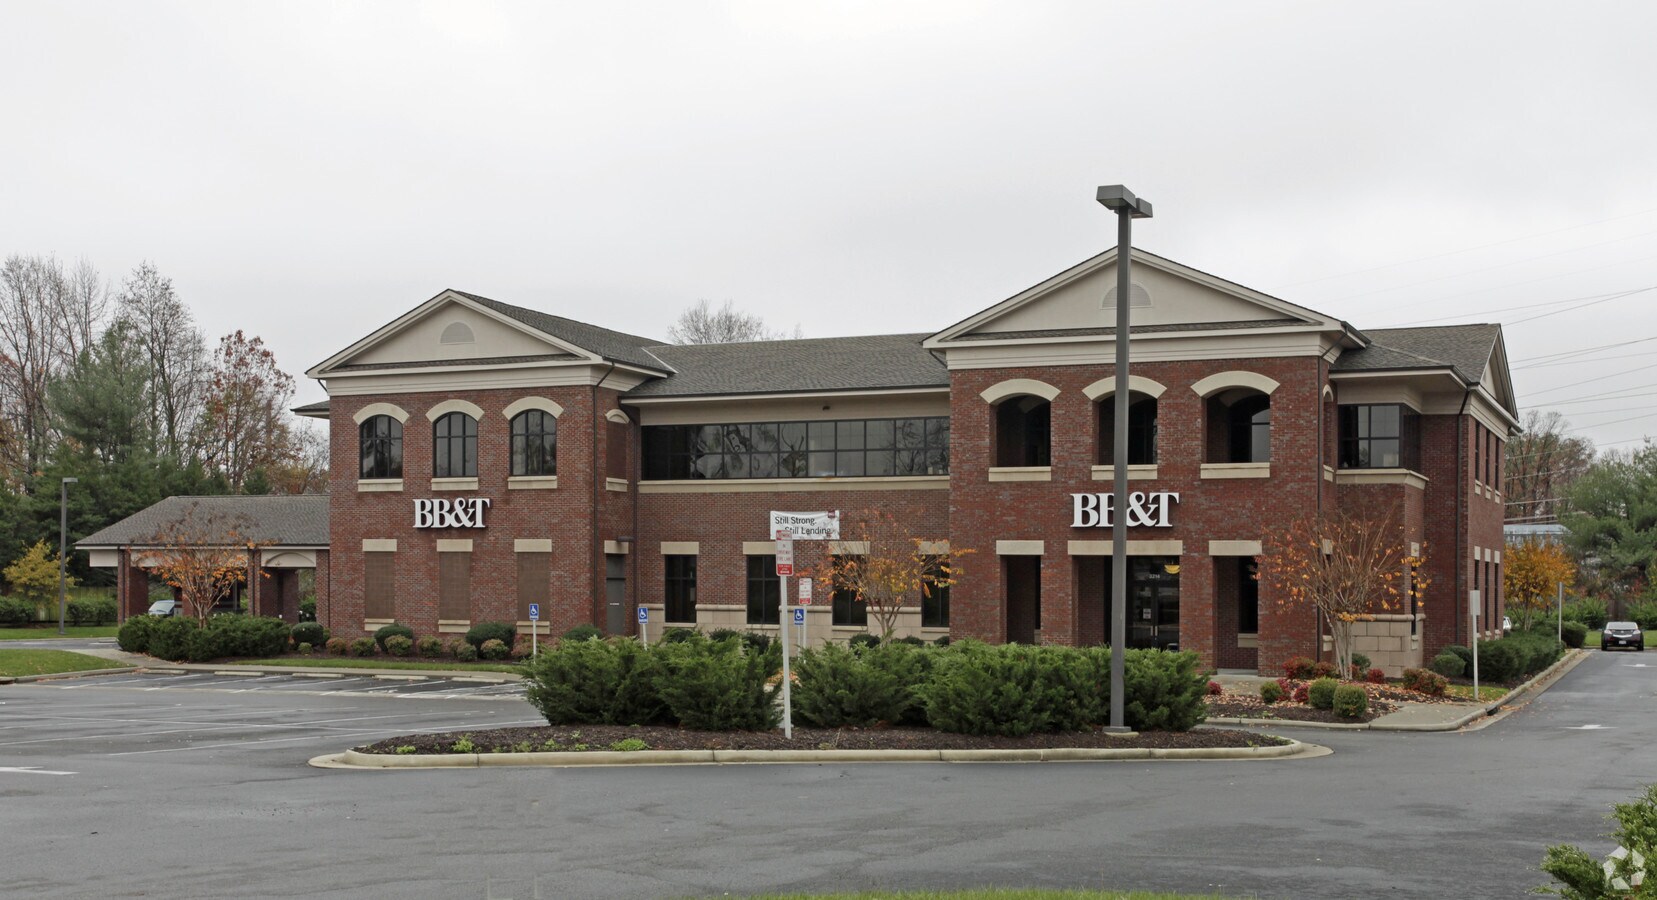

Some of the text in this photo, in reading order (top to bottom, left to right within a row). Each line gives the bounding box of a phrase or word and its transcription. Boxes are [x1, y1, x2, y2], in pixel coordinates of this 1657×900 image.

[412, 497, 490, 528] BB&T
[775, 516, 817, 526] Still Strong.
